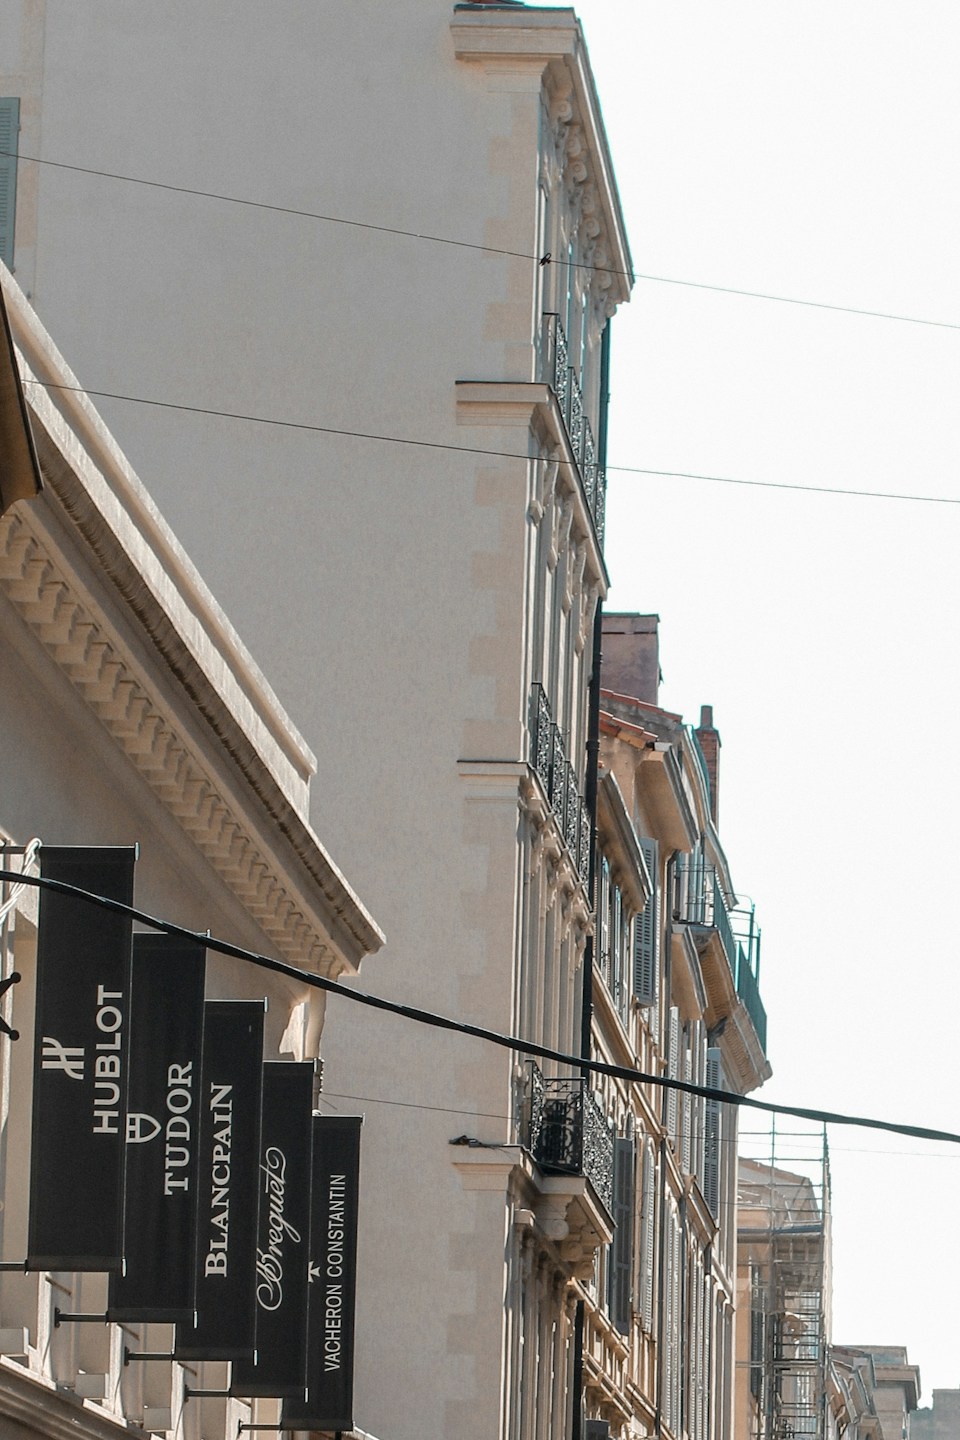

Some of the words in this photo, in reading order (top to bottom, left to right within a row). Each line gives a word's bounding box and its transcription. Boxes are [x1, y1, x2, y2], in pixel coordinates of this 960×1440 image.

[93, 985, 123, 1134] HUBLOT
[164, 1061, 193, 1196] TUDOR
[204, 1082, 233, 1278] BLANCPAIN
[256, 1147, 301, 1312] Breguet
[326, 1174, 346, 1279] CONSTANTIN
[324, 1284, 342, 1372] VACHERON
